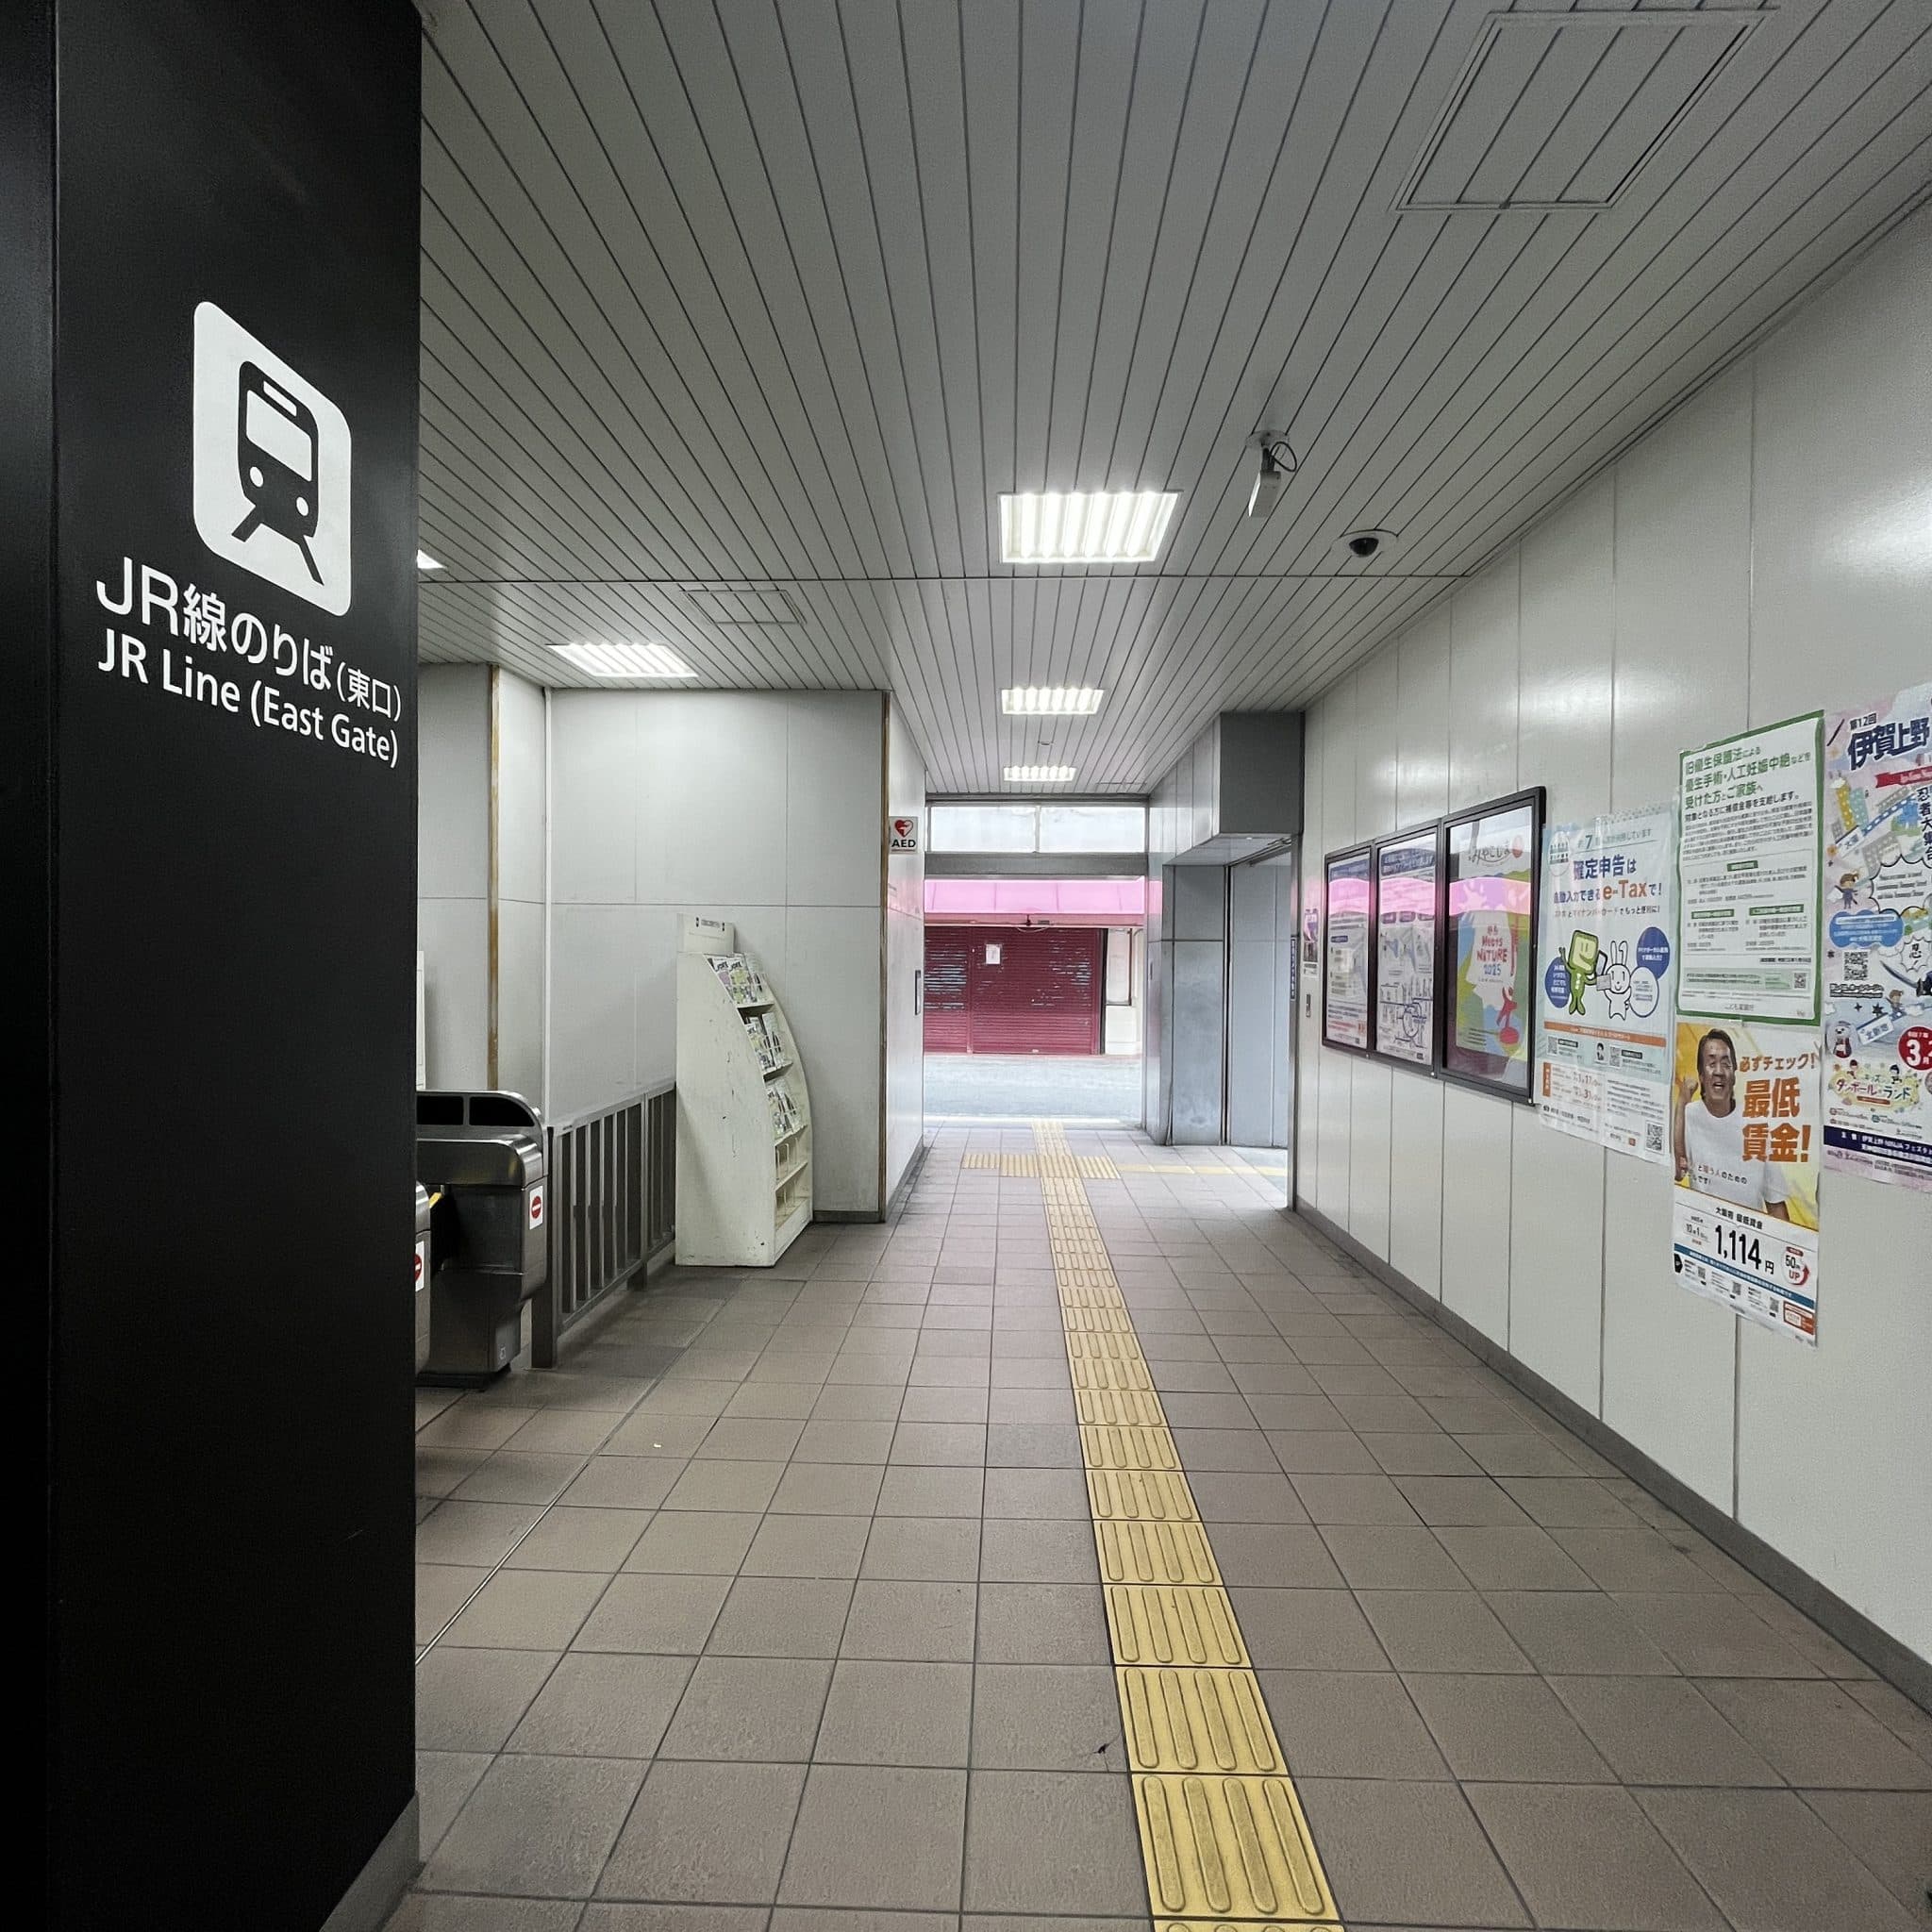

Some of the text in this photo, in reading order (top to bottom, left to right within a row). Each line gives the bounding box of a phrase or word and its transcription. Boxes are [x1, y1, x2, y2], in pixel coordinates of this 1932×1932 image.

[98, 629, 397, 769] JR Line (East Gate)
[1850, 713, 1877, 730] 第12回
[1848, 717, 1930, 771] 伊賀上野
[1574, 854, 1637, 880] 確定申告は
[1740, 1053, 1815, 1072] 必ずチェック!
[1742, 1076, 1800, 1118] 最低
[1742, 1123, 1811, 1163] 賃金!
[1789, 1269, 1801, 1280] UP
